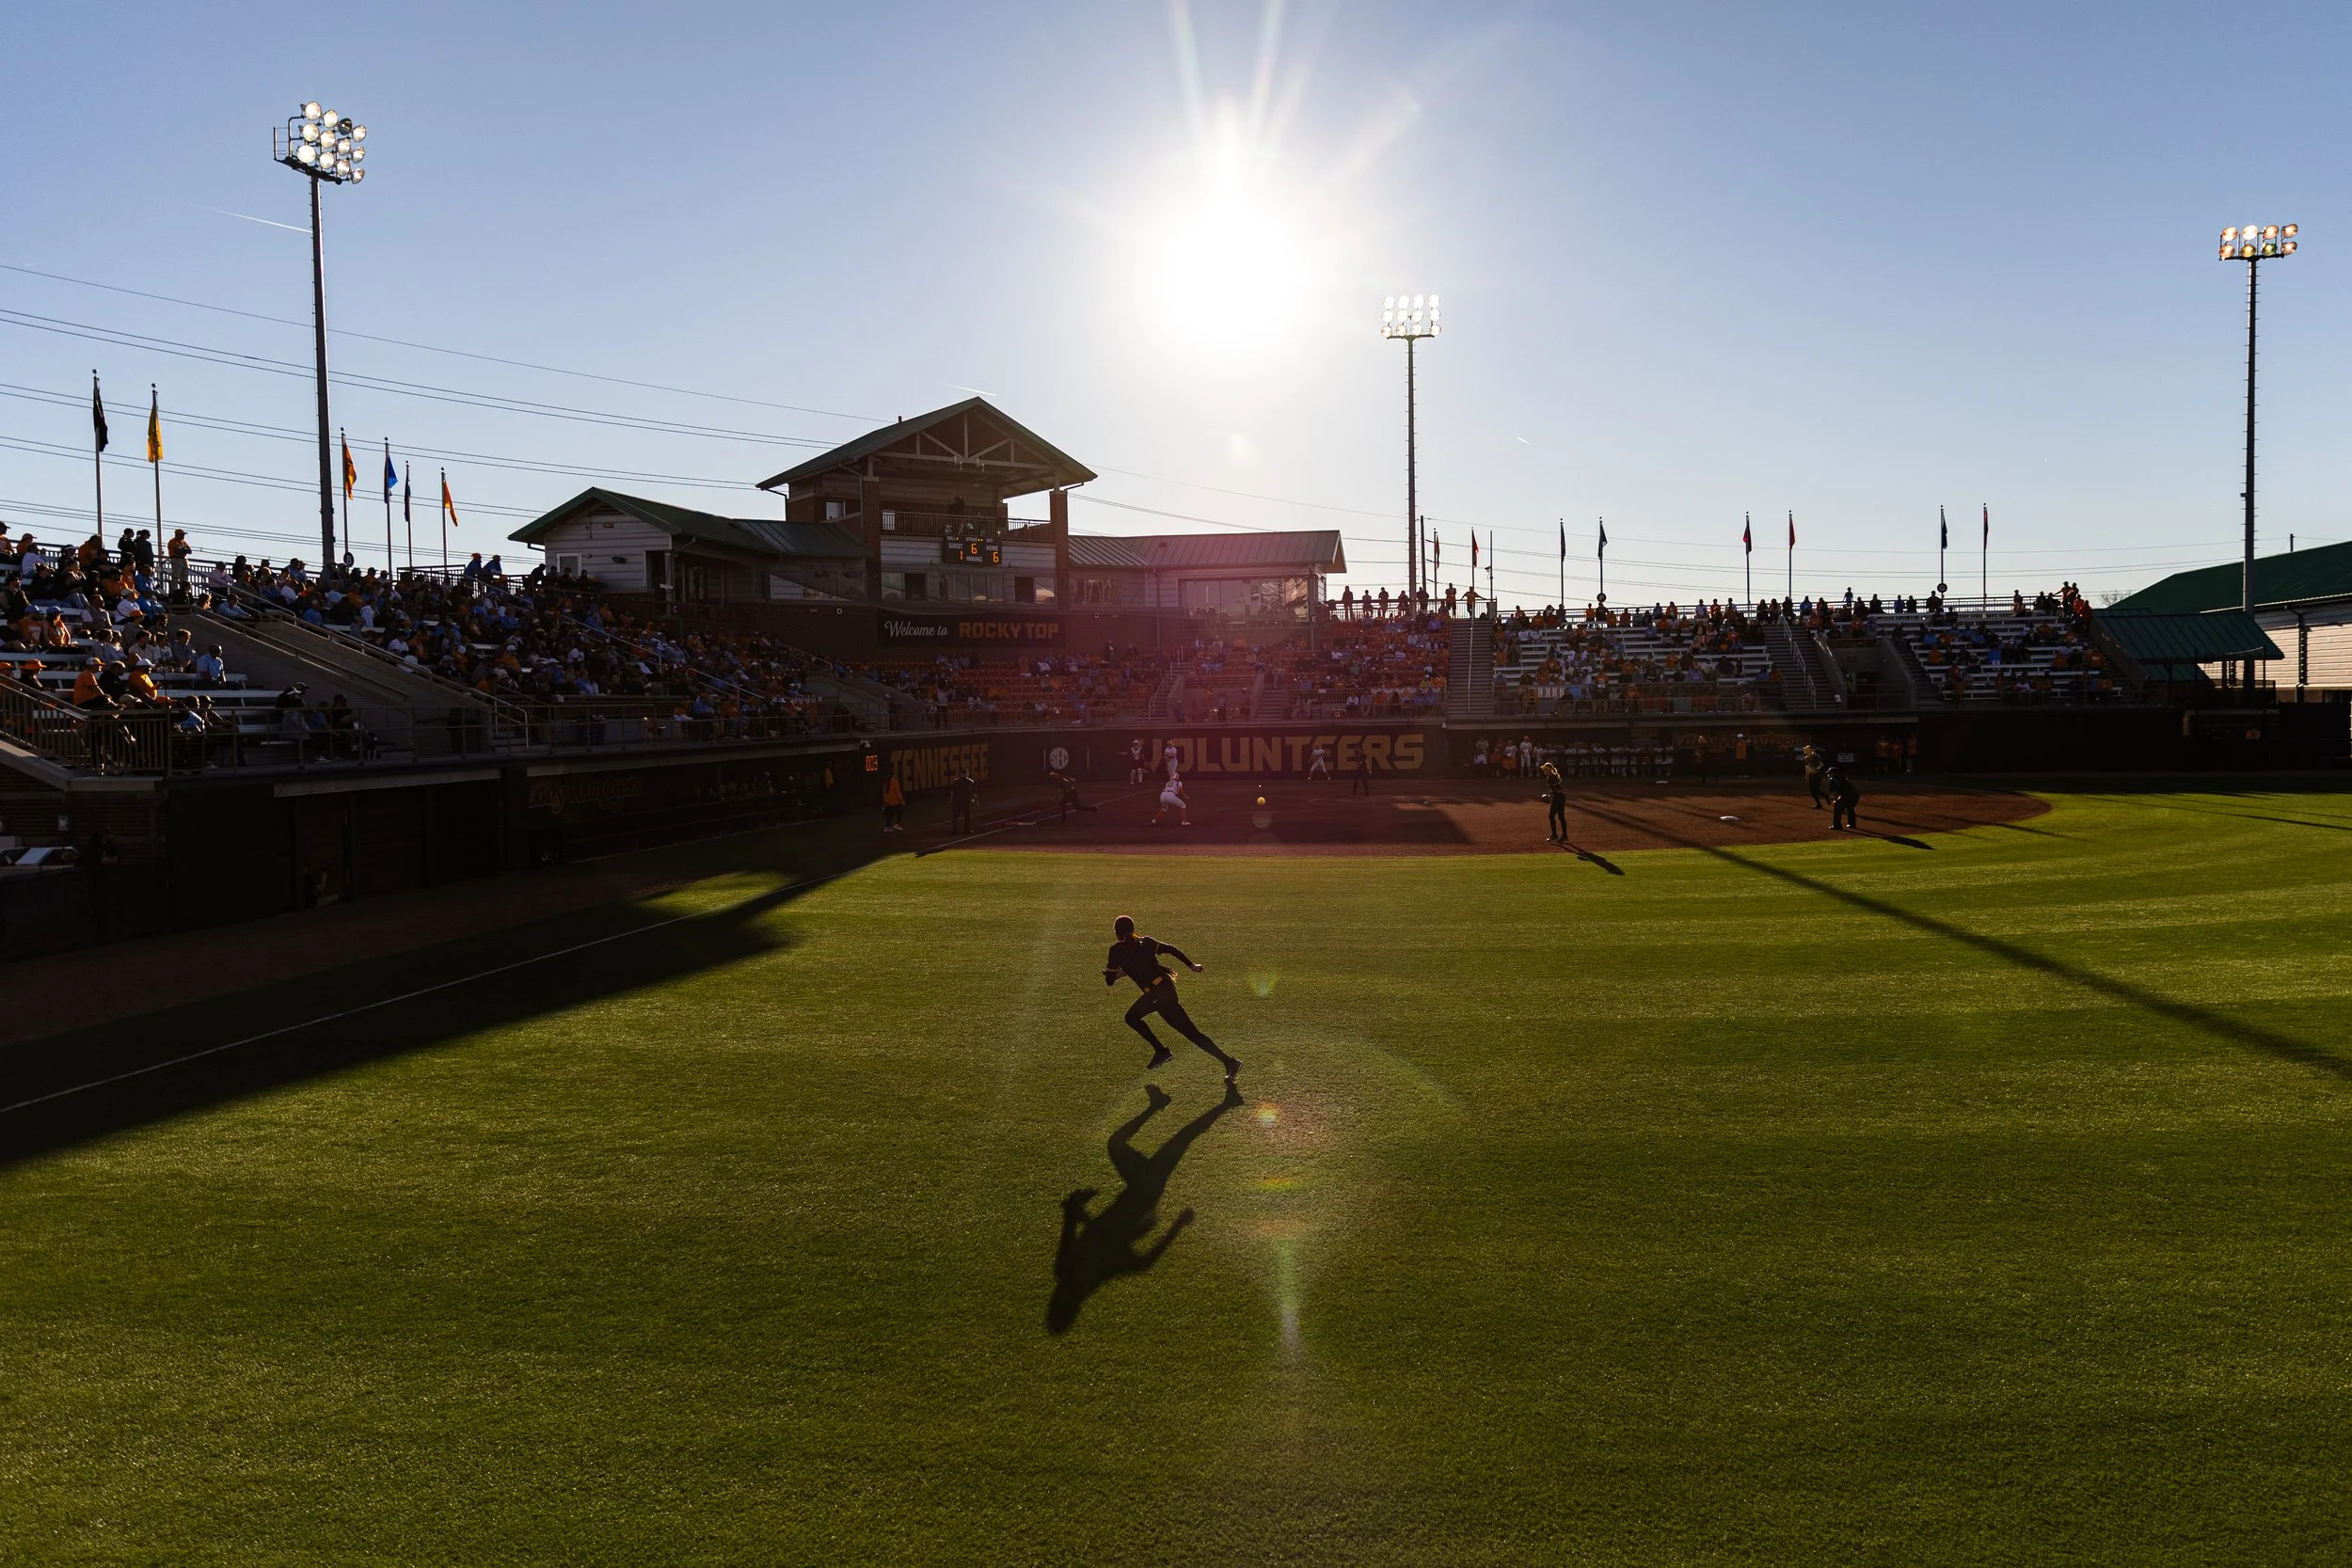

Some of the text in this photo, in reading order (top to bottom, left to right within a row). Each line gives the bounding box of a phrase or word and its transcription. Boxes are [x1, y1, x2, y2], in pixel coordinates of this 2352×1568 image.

[971, 543, 977, 554] 6
[993, 551, 999, 563] 6
[884, 620, 1059, 640] Welcome to ROCKY TOP
[889, 743, 988, 792] TENNESSEE
[1049, 748, 1069, 768] SEC
